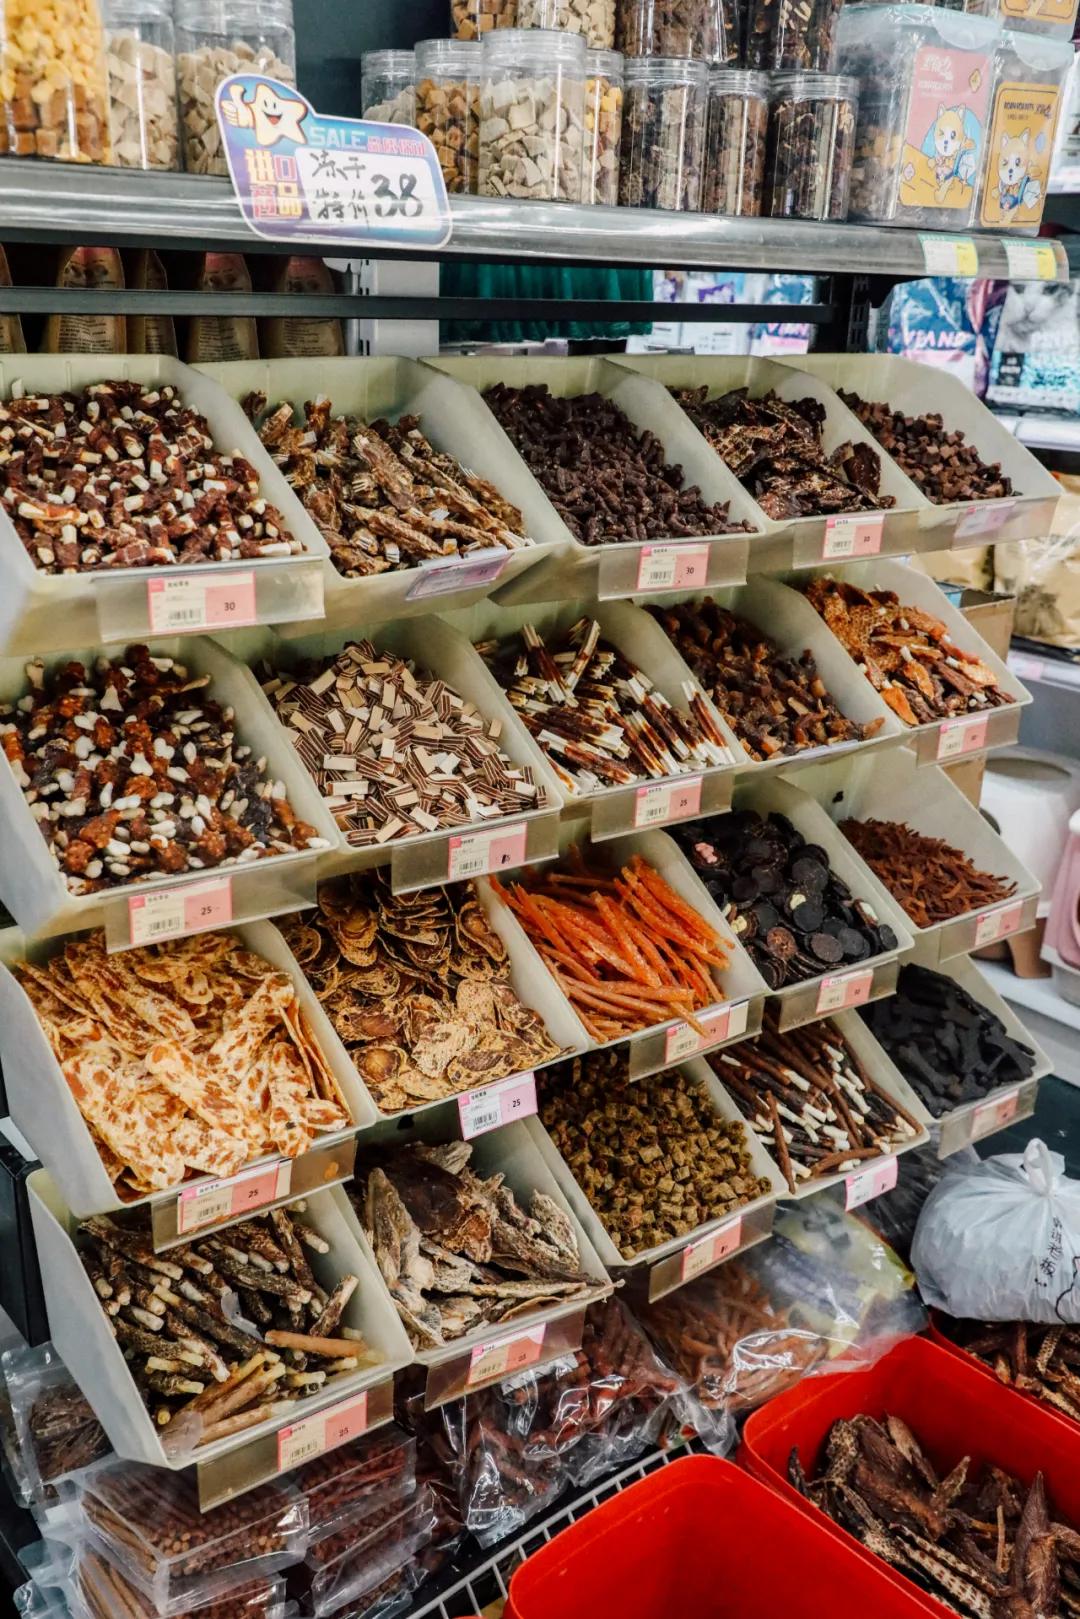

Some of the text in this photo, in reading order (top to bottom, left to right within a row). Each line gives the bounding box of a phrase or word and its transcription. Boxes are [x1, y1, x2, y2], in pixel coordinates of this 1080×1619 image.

[309, 126, 366, 149] SALE
[244, 148, 298, 185] 进口
[310, 149, 367, 181] 冻干
[252, 181, 303, 220] 商品
[312, 173, 424, 231] 特价 38
[686, 566, 695, 575] 30
[224, 602, 236, 612] 30
[680, 798, 689, 808] 25
[201, 906, 212, 916] 25
[512, 1098, 521, 1109] 25
[248, 1188, 259, 1199] 25
[339, 1427, 349, 1438] 25
